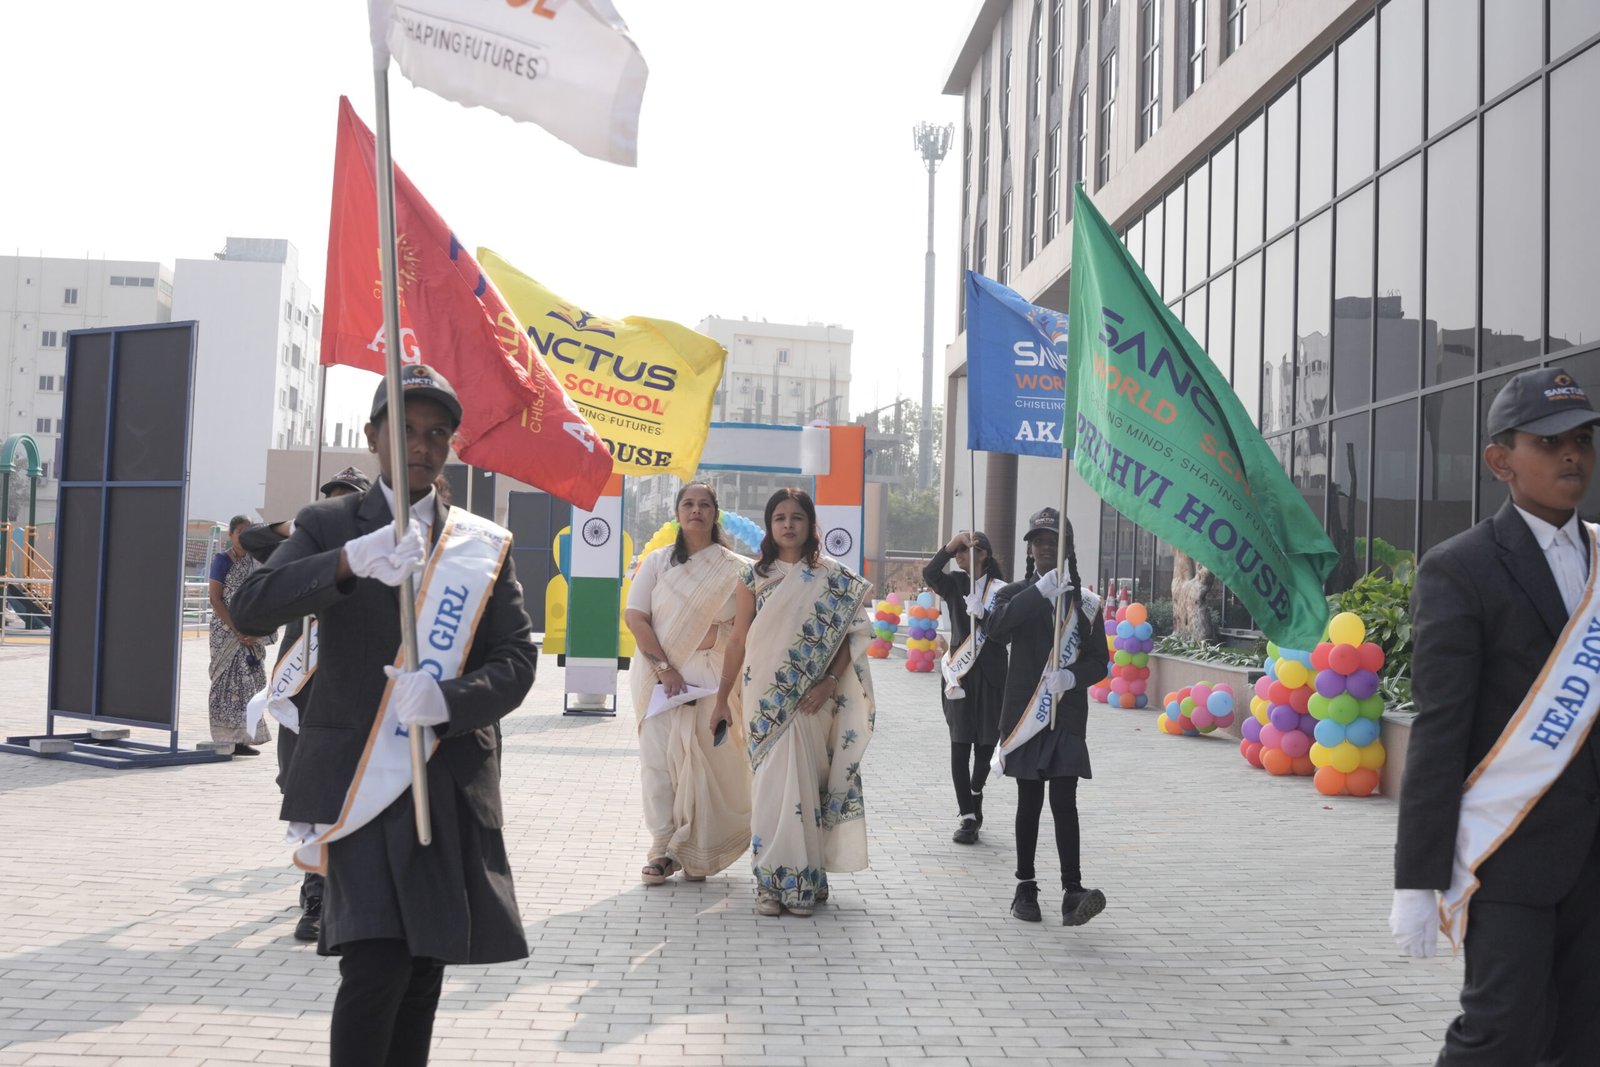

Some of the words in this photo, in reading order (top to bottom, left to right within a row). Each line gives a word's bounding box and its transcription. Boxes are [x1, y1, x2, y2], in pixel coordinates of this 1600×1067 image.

[402, 17, 461, 54] HAPING
[464, 35, 540, 81] FUTURES
[563, 373, 665, 416] SCHOOL
[1093, 351, 1178, 424] WORLD
[610, 416, 662, 436] FUTURES
[1077, 411, 1174, 508] PRITHVI
[1174, 493, 1291, 622] HOUSE
[1180, 458, 1242, 511] SHAPING
[428, 585, 470, 652] GIRL
[1530, 674, 1591, 751] HEAD
